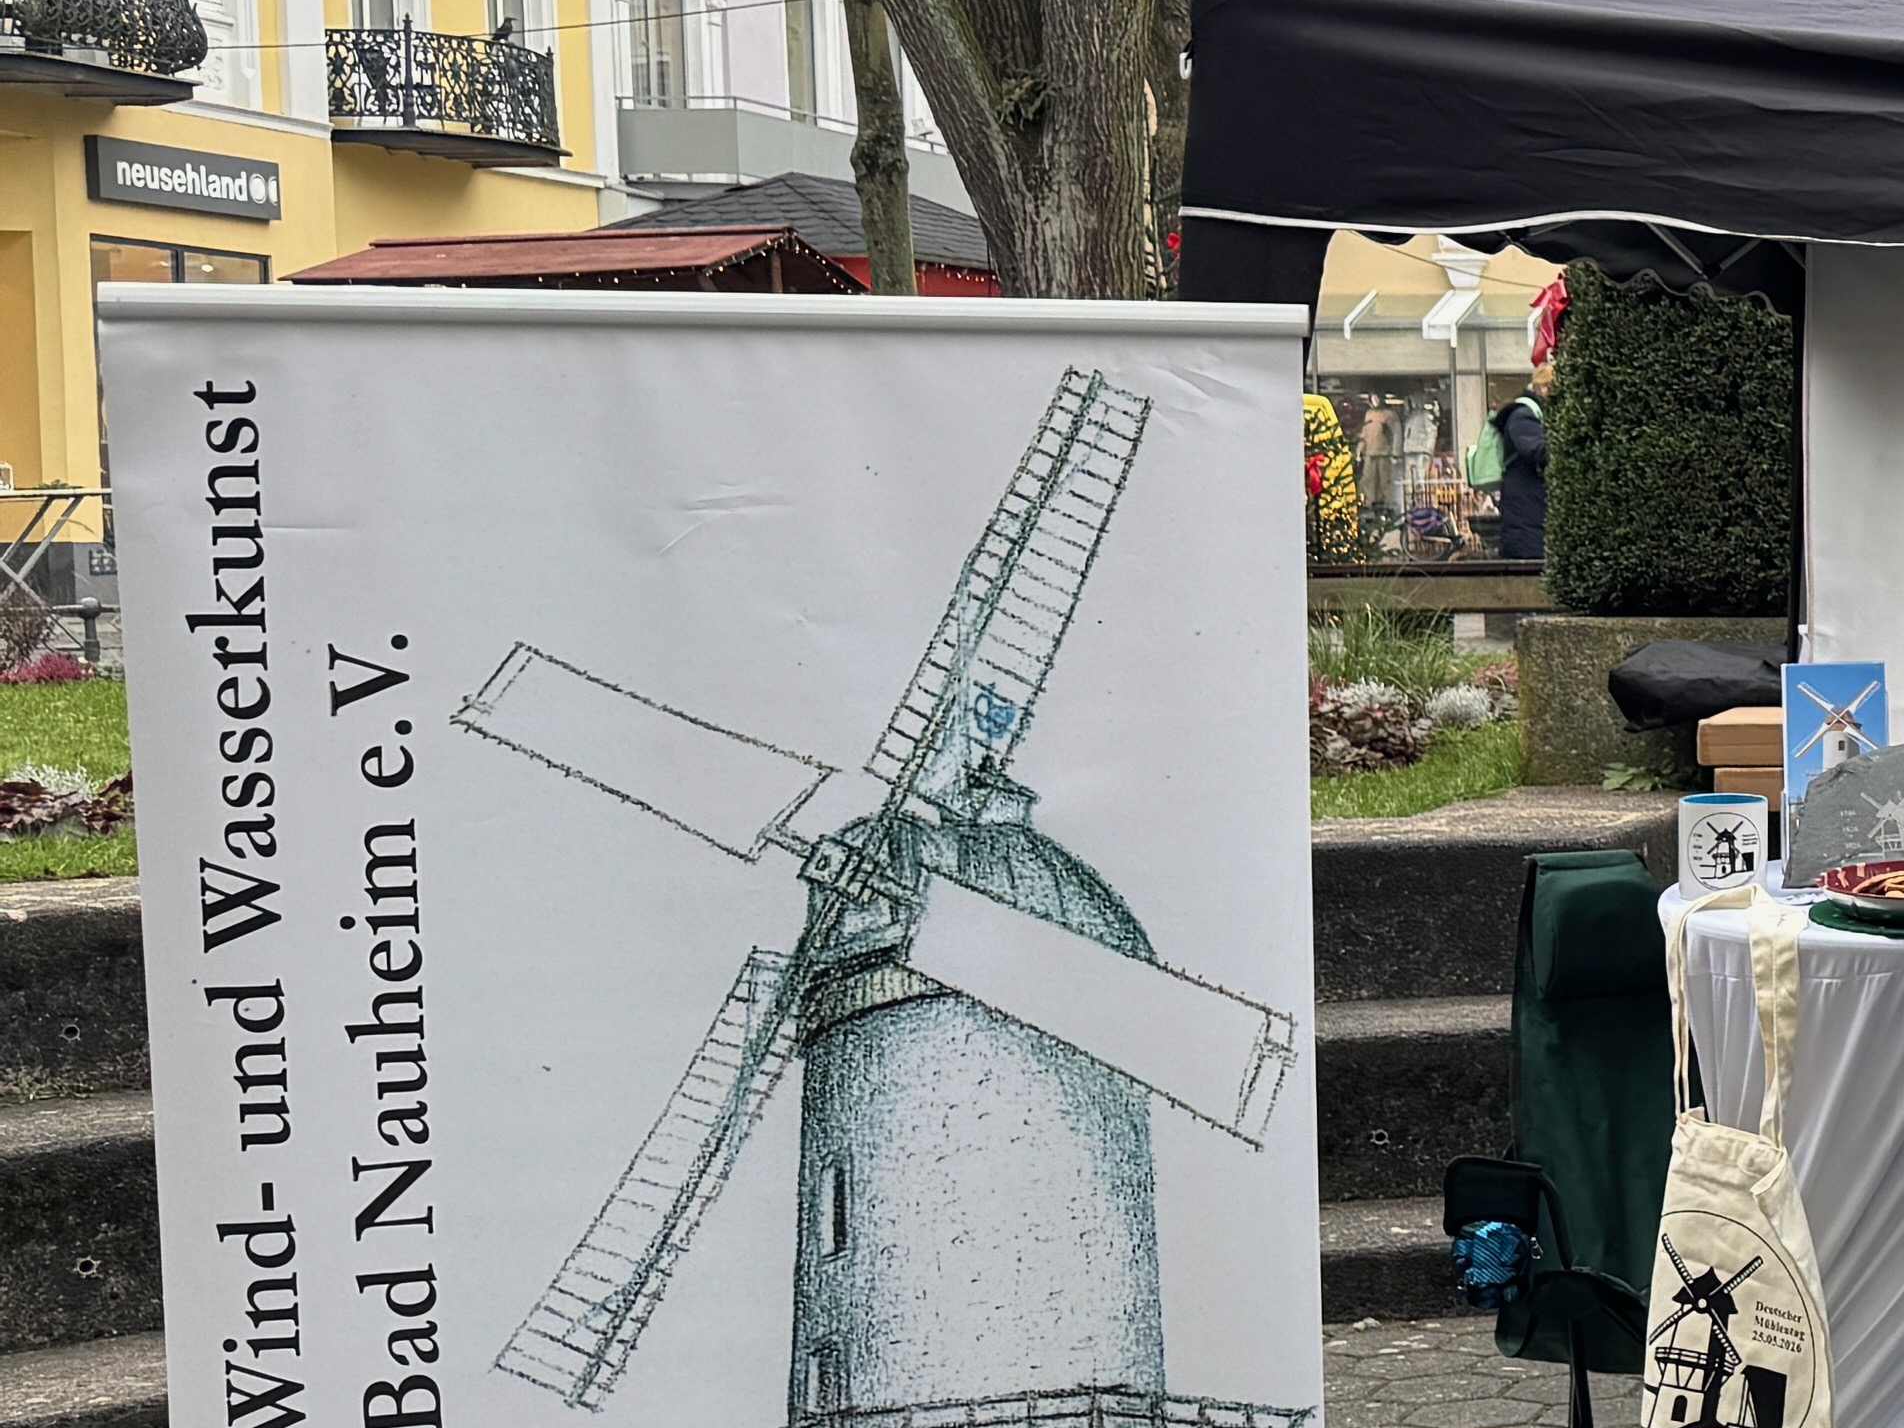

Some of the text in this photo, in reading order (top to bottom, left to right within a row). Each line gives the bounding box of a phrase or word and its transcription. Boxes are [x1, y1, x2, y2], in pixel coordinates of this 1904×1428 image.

[116, 160, 249, 203] neusehland
[185, 378, 282, 954] Wasserkunst
[203, 978, 292, 1152] und
[339, 818, 433, 1242] Nauheim
